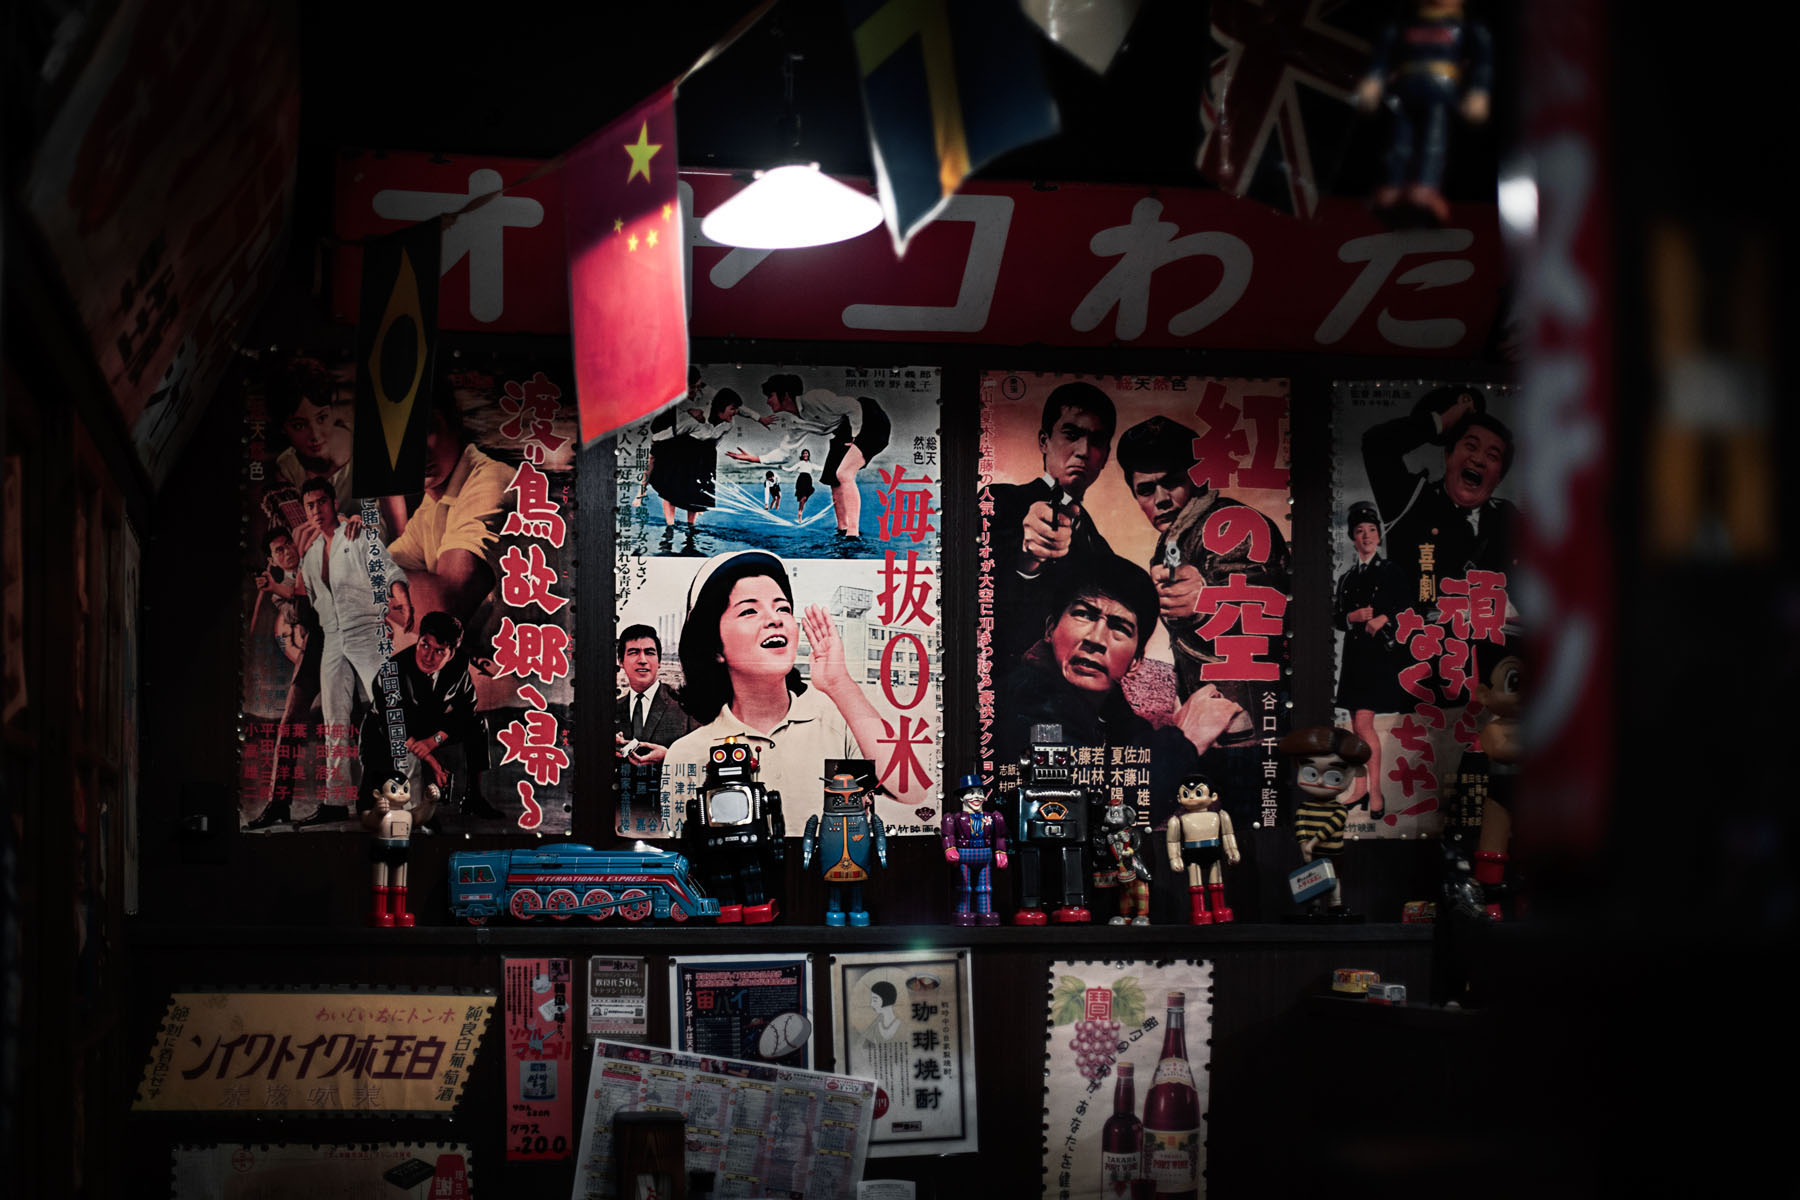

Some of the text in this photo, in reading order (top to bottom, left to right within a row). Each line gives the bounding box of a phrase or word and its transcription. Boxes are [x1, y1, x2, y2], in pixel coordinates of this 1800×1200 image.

[1187, 381, 1290, 681] 紅の空
[1418, 542, 1437, 603] 喜劇
[492, 371, 570, 829] 渡り鳥故郷へ帰る
[1137, 745, 1151, 826] 加山雄三
[1261, 691, 1279, 828] 谷口千吉・監督
[535, 875, 649, 883] INTERNATIONAL EXPRESS
[911, 1001, 942, 1110] 珈琲焼酎
[510, 1123, 540, 1135] グラス
